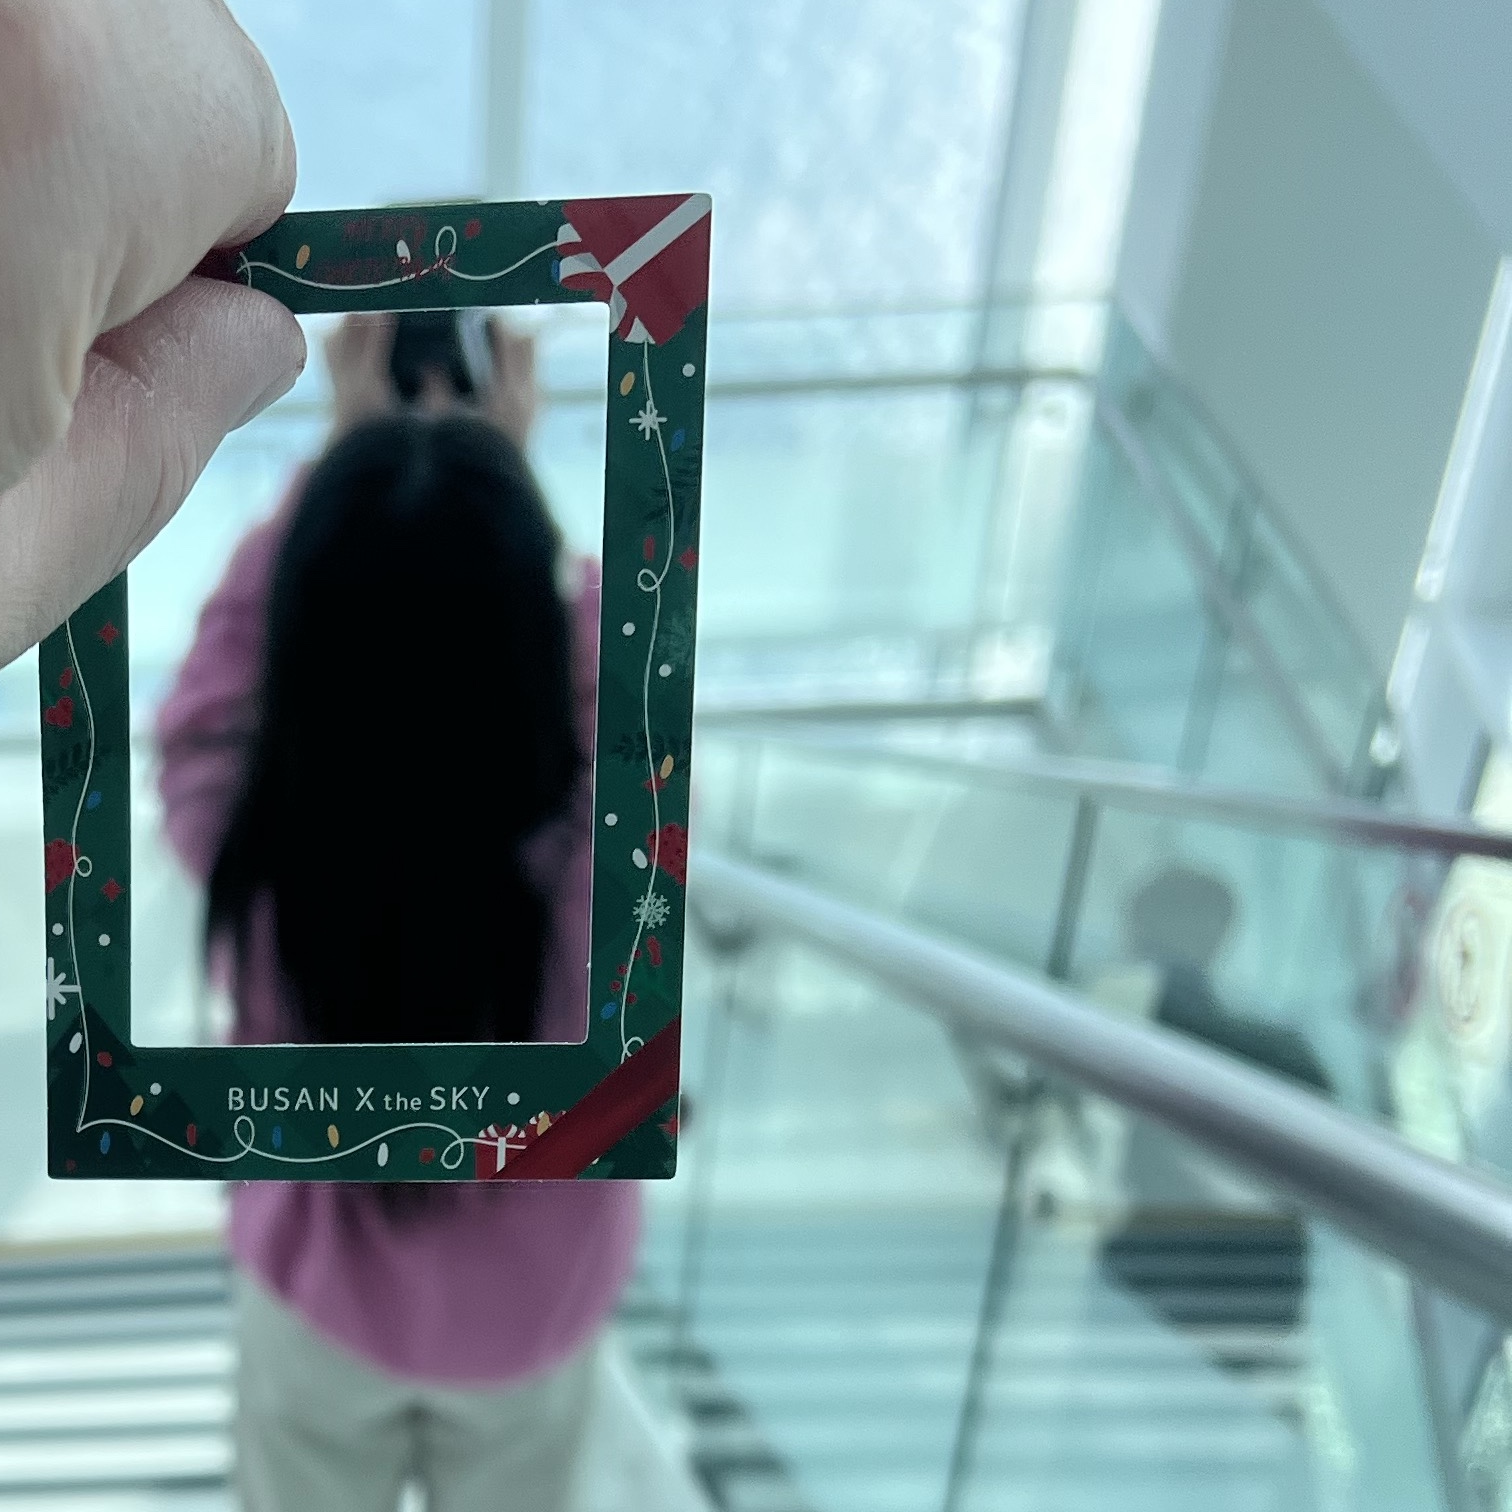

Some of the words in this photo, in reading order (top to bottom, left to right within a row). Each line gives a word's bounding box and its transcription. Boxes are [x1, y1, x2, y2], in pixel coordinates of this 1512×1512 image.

[228, 1086, 339, 1112] BUSAN
[355, 1087, 376, 1111] X
[384, 1092, 422, 1111] the
[430, 1086, 490, 1111] SKY
